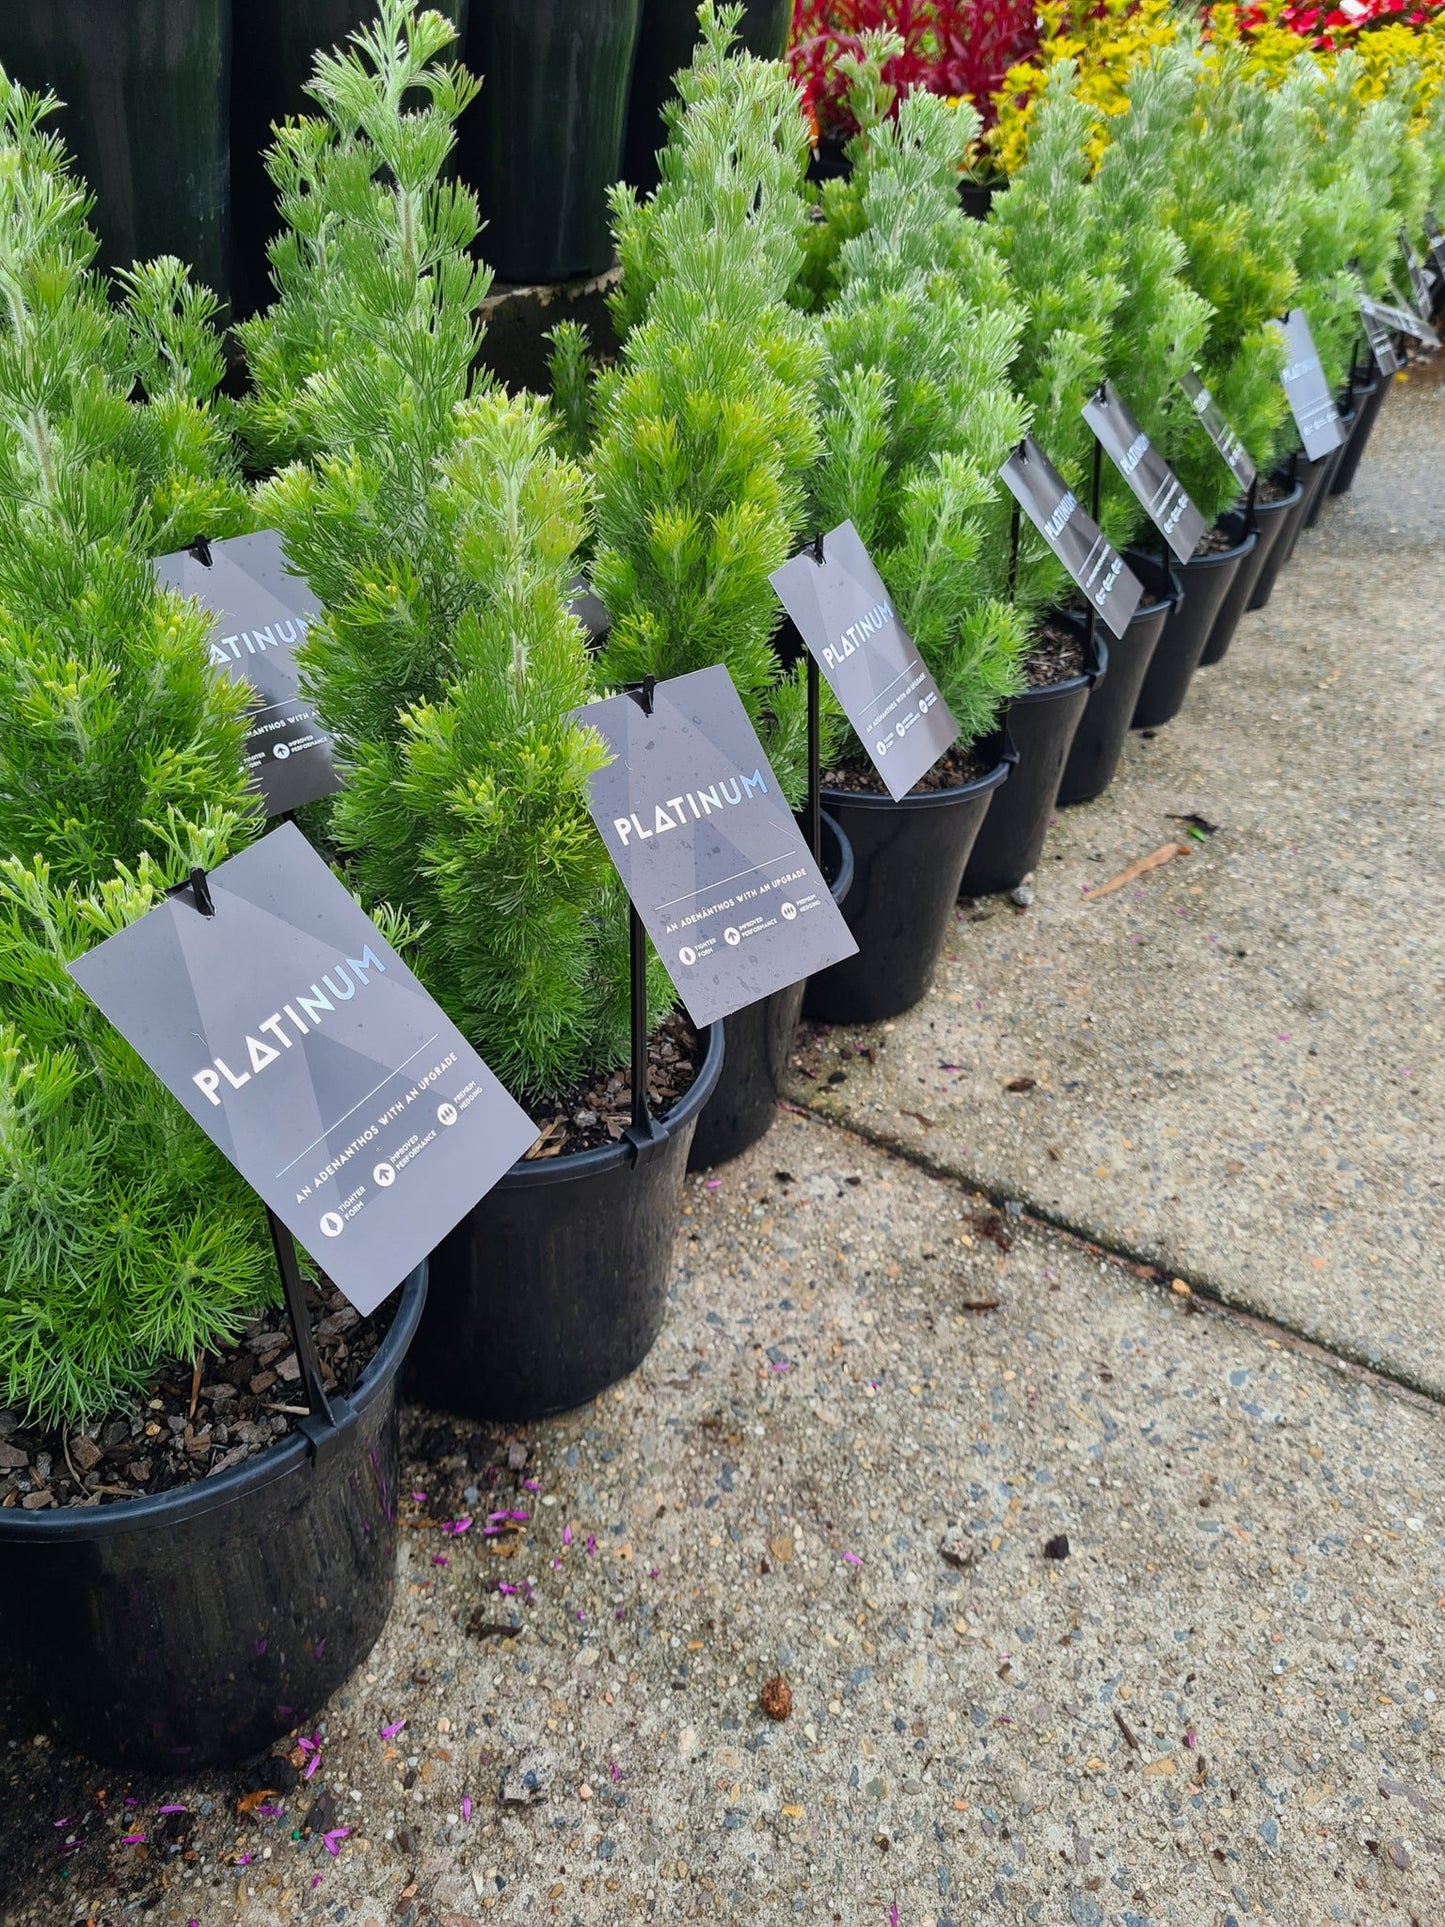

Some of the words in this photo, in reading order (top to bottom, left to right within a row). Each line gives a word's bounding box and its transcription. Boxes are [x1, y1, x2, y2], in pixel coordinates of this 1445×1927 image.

[209, 614, 317, 666] ATINU
[822, 599, 895, 670] PLATINUM
[245, 719, 287, 737] NANTHOS
[287, 712, 310, 724] WITH
[613, 769, 768, 846] PLATINUM
[665, 921, 679, 934] AN
[680, 899, 735, 928] ADENANTHOS
[735, 888, 758, 905] WITH
[759, 882, 771, 895] AN
[771, 867, 808, 890] UPGRADE
[742, 918, 778, 938] PERFORMANCE
[694, 937, 717, 951] TIGHTER
[697, 947, 714, 958] FORM
[192, 943, 387, 1106] PLATINUM
[453, 1080, 477, 1104] PREMIUM
[458, 1086, 483, 1111] HEDGING
[296, 1185, 313, 1205] AN
[313, 1125, 380, 1188] ADENANTHOS
[378, 1101, 405, 1126] WITH
[404, 1087, 420, 1104] AN
[418, 1052, 458, 1091] UPGRADE
[389, 1134, 419, 1164] IMPROVED
[395, 1129, 437, 1171] PERFORMANCE
[338, 1185, 366, 1213] TIGHTER
[344, 1200, 365, 1221] FORM
